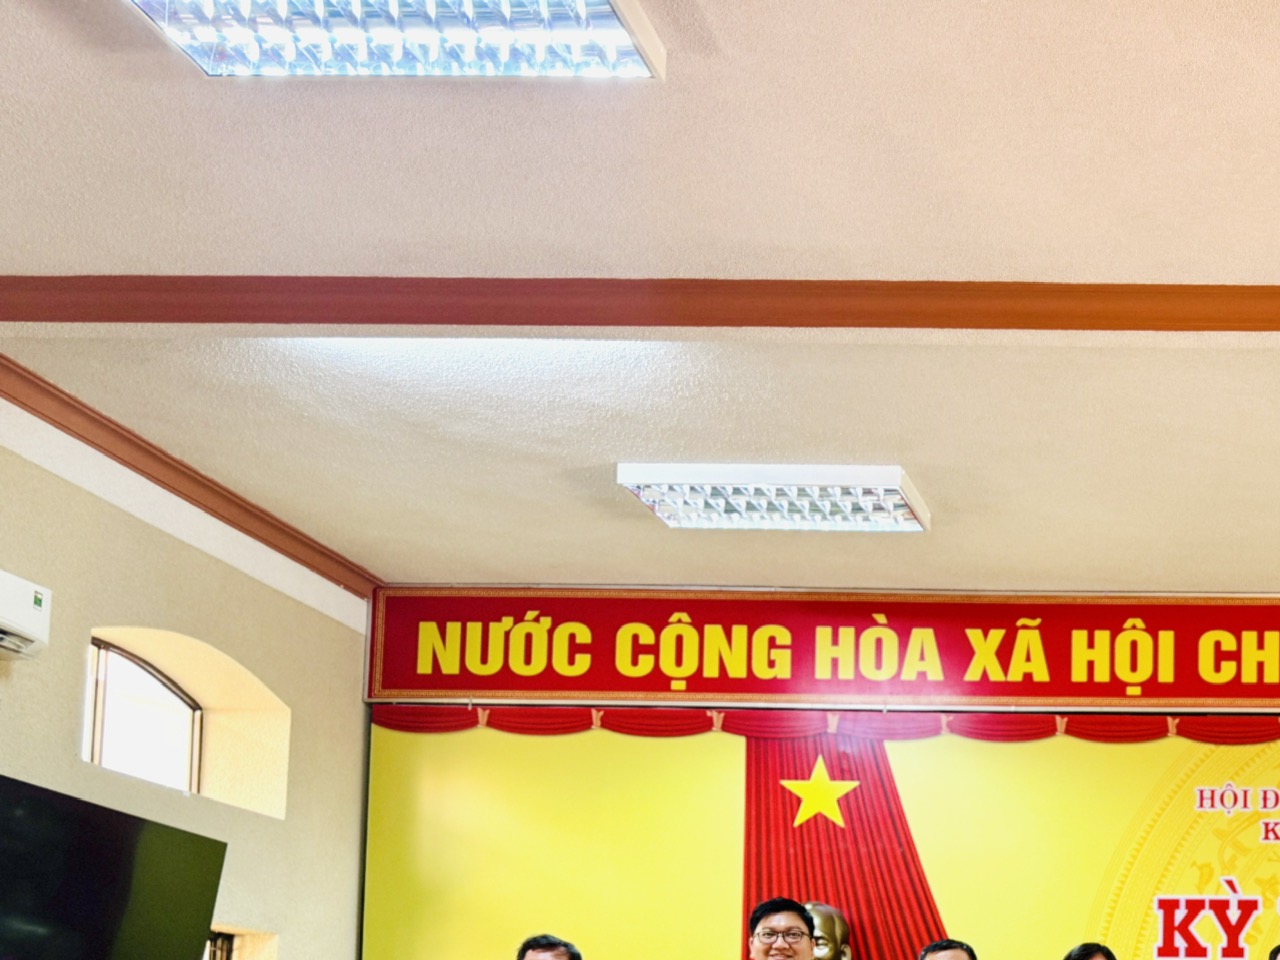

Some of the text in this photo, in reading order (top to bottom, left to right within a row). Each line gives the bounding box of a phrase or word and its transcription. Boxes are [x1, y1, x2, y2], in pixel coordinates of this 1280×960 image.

[417, 610, 592, 677] NƯỚC
[615, 612, 792, 691] CỘNG
[815, 614, 943, 681] HÒA
[964, 618, 1050, 682] XÃ
[1071, 613, 1175, 696] HỘI
[1197, 783, 1250, 814] HỘI
[1156, 879, 1259, 958] KỲ
